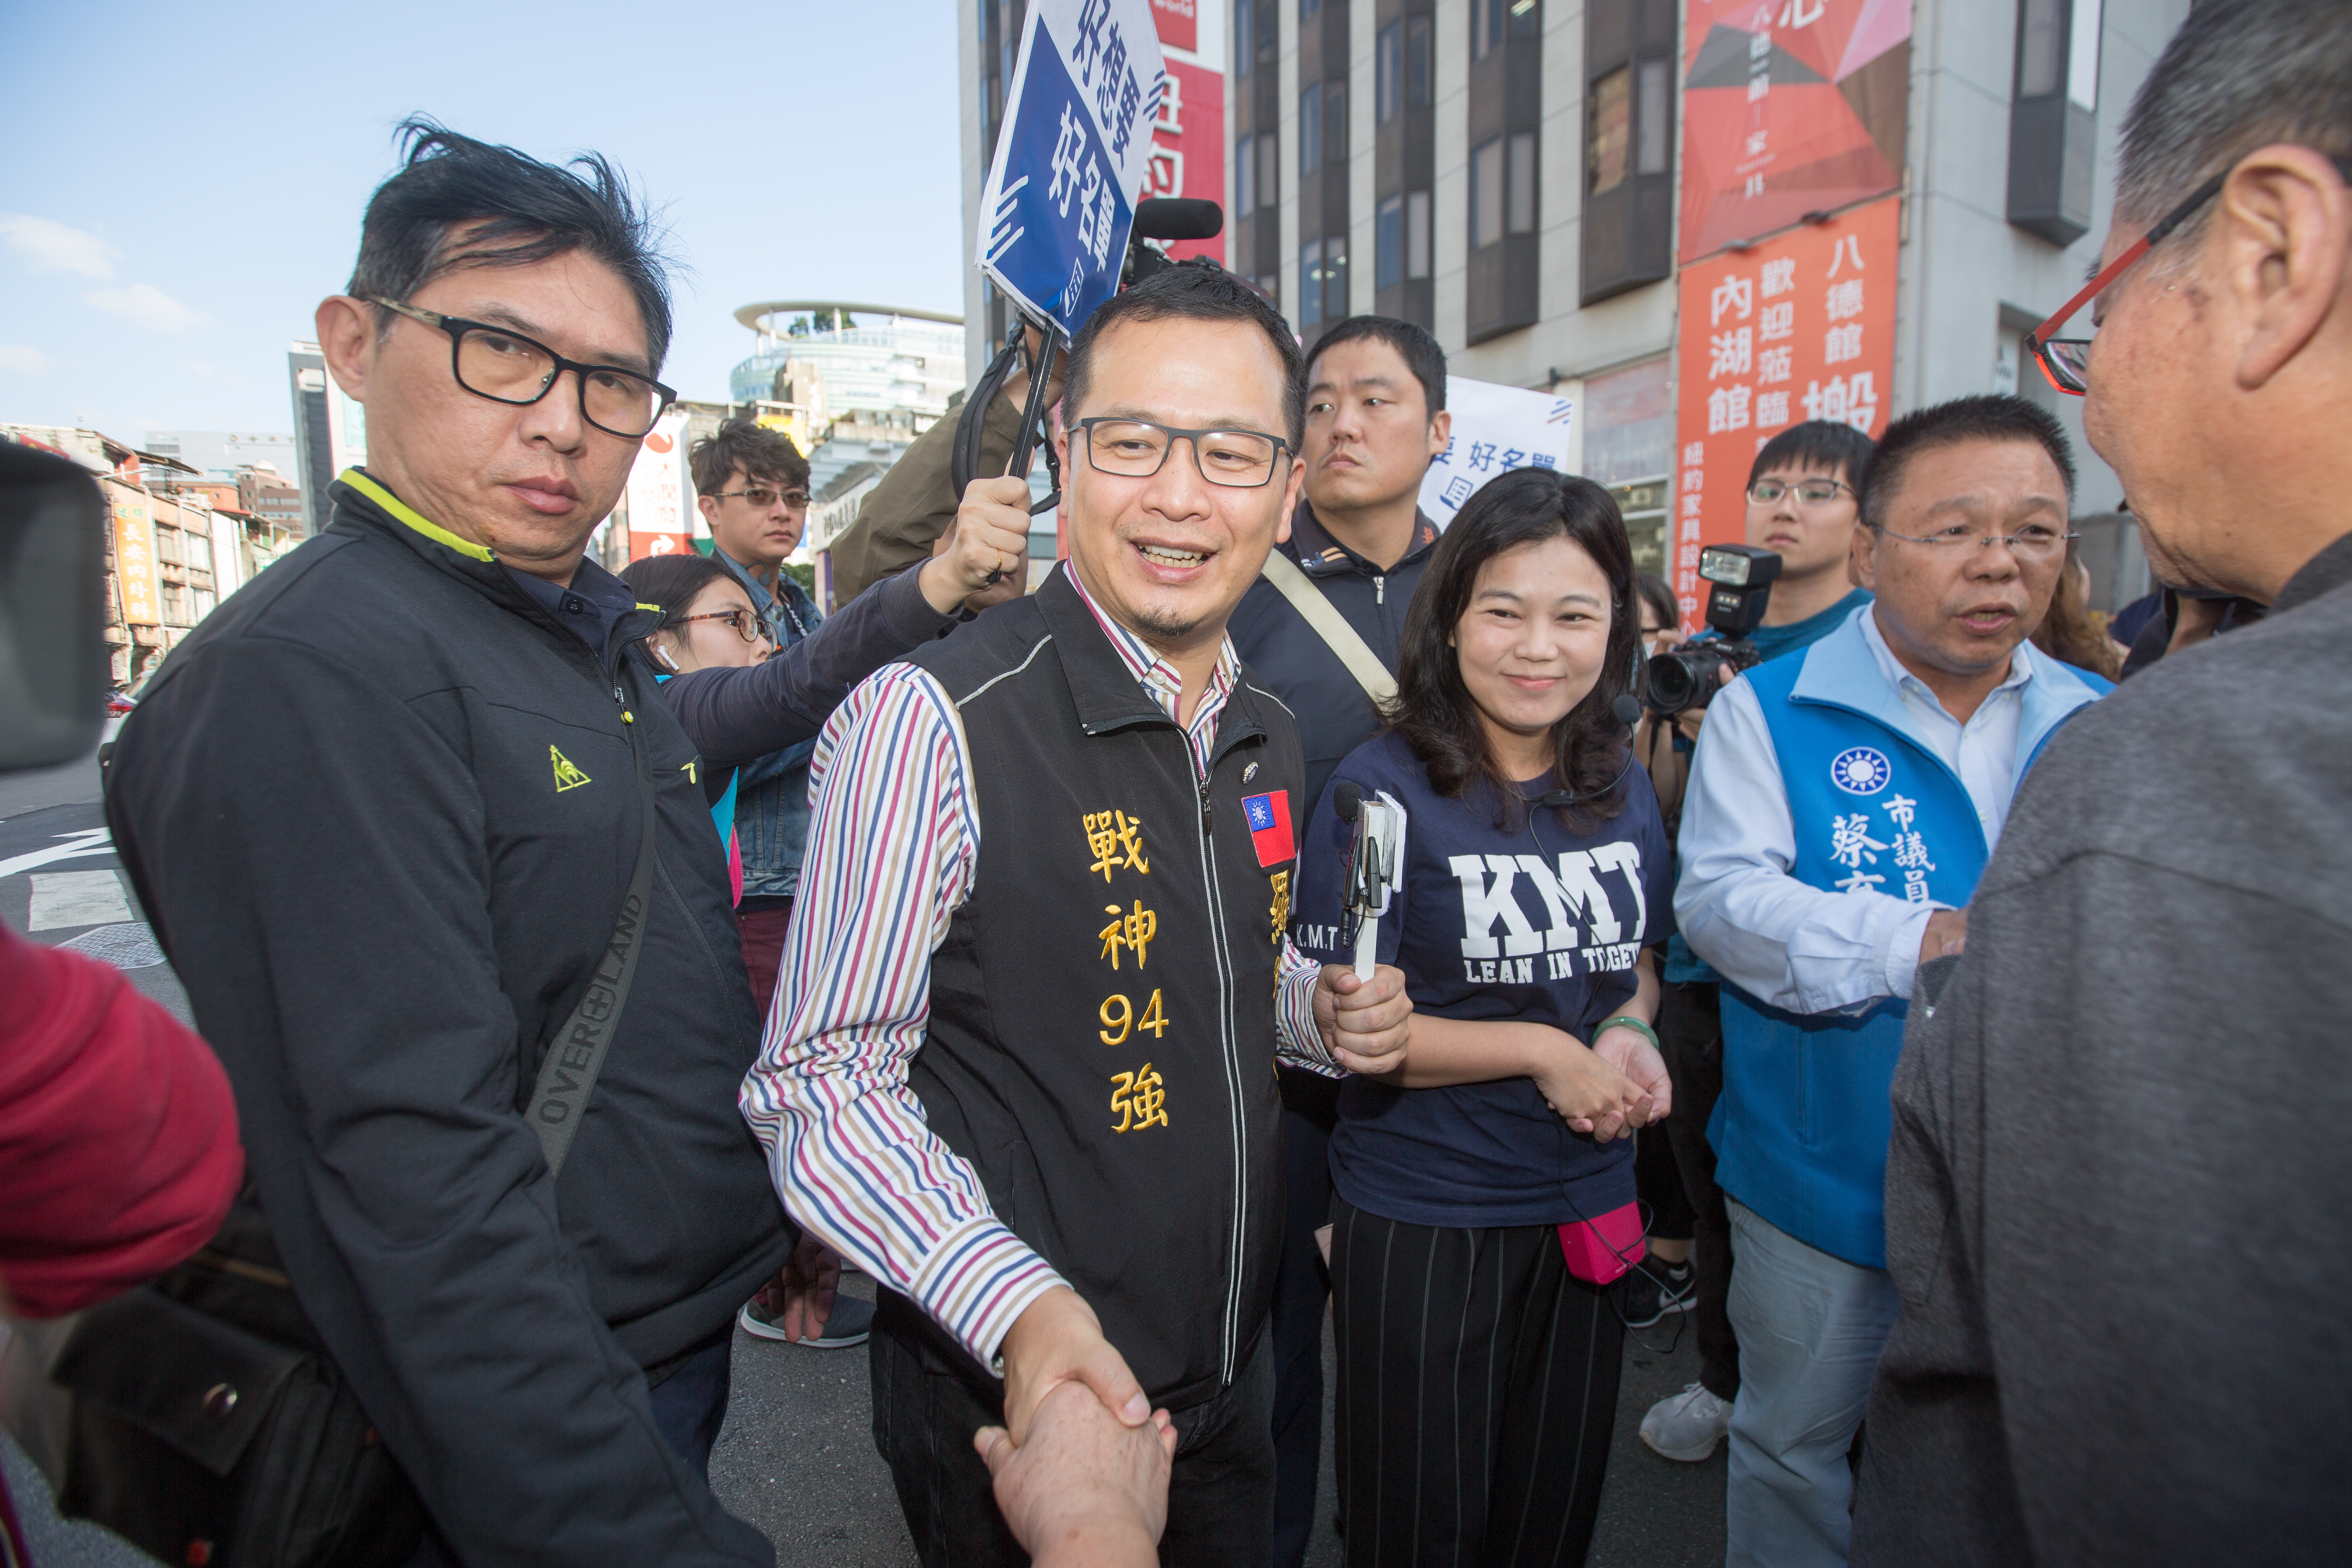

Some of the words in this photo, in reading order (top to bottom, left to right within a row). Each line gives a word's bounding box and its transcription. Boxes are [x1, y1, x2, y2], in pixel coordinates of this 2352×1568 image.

[1049, 100, 1115, 273] 好名單
[1707, 274, 1753, 435] 內湖館
[1825, 234, 1865, 366] 八德館
[1448, 841, 1646, 958] KMT
[1882, 793, 1936, 903] 市議員
[1464, 958, 1533, 984] LEAN
[1547, 951, 1573, 980] IN
[1581, 941, 1642, 973] TOGET
